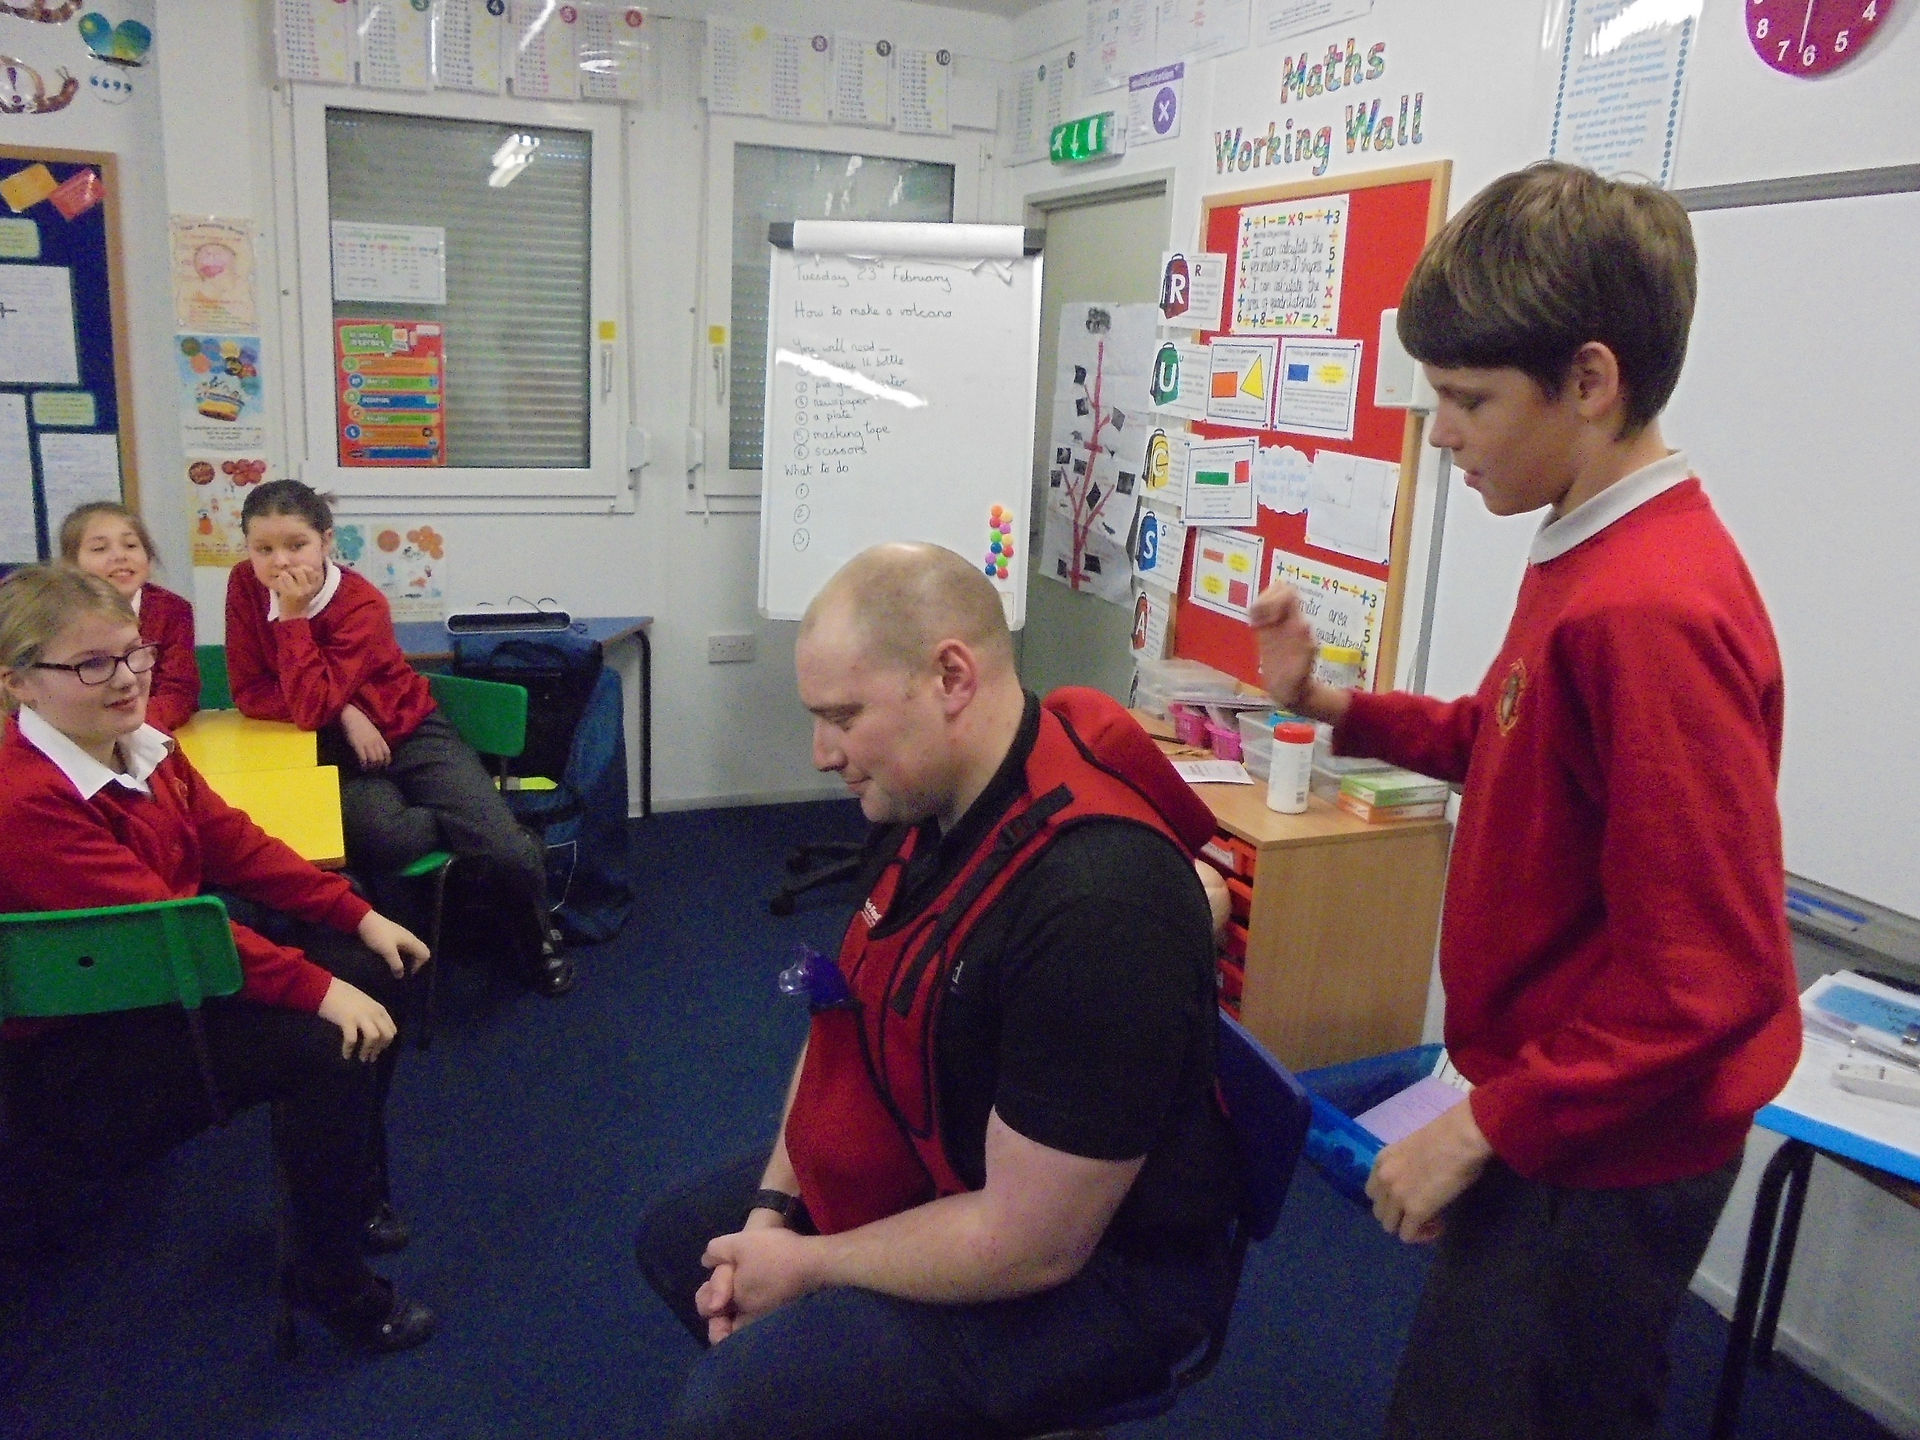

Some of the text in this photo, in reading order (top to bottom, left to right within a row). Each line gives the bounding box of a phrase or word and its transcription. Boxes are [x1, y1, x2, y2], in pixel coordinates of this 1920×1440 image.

[1862, 0, 1877, 21] 4
[1756, 18, 1769, 39] 8
[1778, 40, 1791, 62] 7
[1834, 30, 1849, 53] 5
[1802, 44, 1816, 67] 6
[1280, 37, 1385, 104] Maths
[1215, 118, 1332, 177] Working
[1345, 92, 1423, 154] Wall
[1262, 210, 1341, 228] 1 9 3
[1329, 246, 1336, 260] 5
[794, 264, 849, 288] Tuesday
[893, 265, 952, 292] February
[1194, 264, 1202, 277] R
[1241, 261, 1246, 273] 4
[1169, 273, 1186, 304] R
[795, 300, 823, 318] How
[832, 304, 842, 316] to
[850, 303, 880, 316] make
[900, 302, 952, 318] volcano
[1237, 310, 1319, 328] 6 8 7 2
[1160, 361, 1177, 392] U
[813, 426, 865, 447] masking
[863, 420, 890, 440] tape
[785, 460, 849, 476] What to do
[1161, 525, 1167, 537] S
[1144, 530, 1156, 559] S
[1296, 567, 1300, 580] 1
[1332, 579, 1339, 594] 9
[1369, 594, 1378, 608] 3
[1136, 610, 1146, 640] A
[1363, 629, 1371, 644] 5
